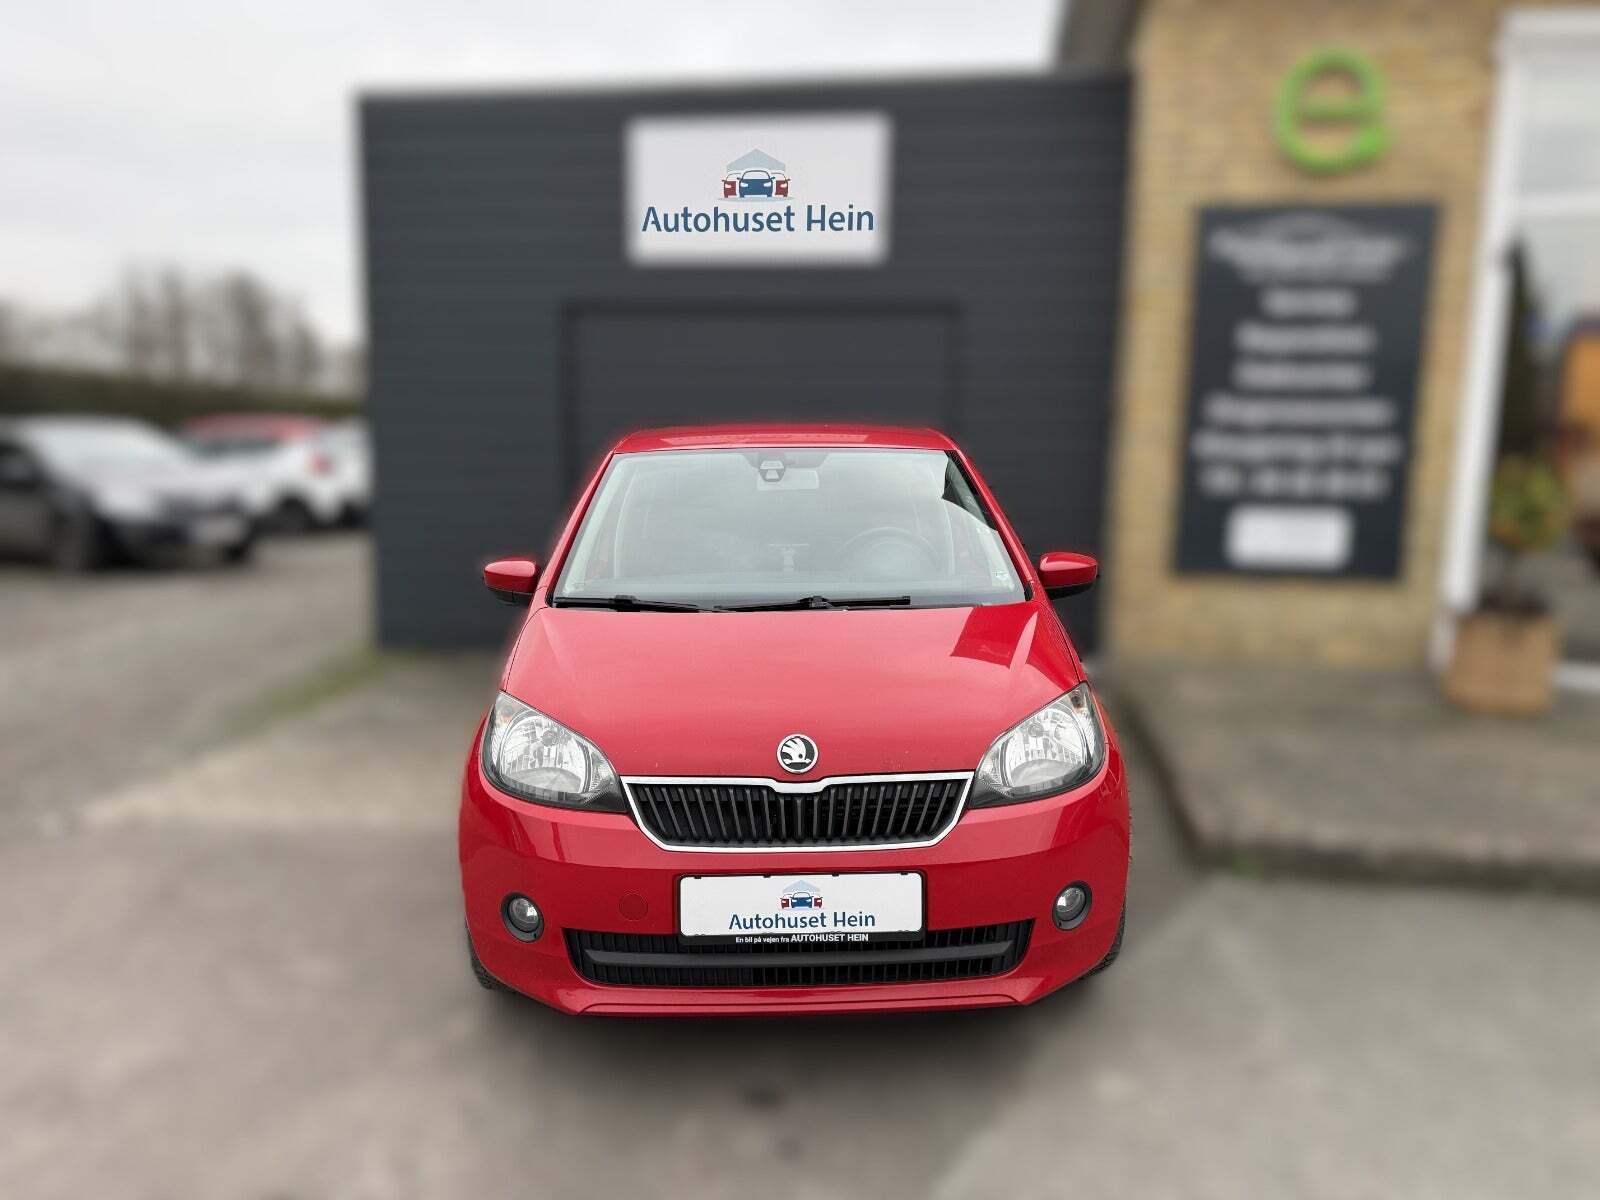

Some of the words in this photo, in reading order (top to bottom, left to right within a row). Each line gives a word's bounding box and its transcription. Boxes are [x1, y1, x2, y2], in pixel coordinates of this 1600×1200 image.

[1273, 50, 1388, 172] e
[642, 204, 795, 232] Autohuset
[806, 204, 874, 231] Hein
[728, 914, 826, 929] Autohuset
[833, 911, 876, 927] Hein
[763, 936, 780, 944] vejen
[781, 935, 790, 943] fra
[791, 933, 846, 942] AUTOHUSET
[848, 932, 869, 941] HEIN
